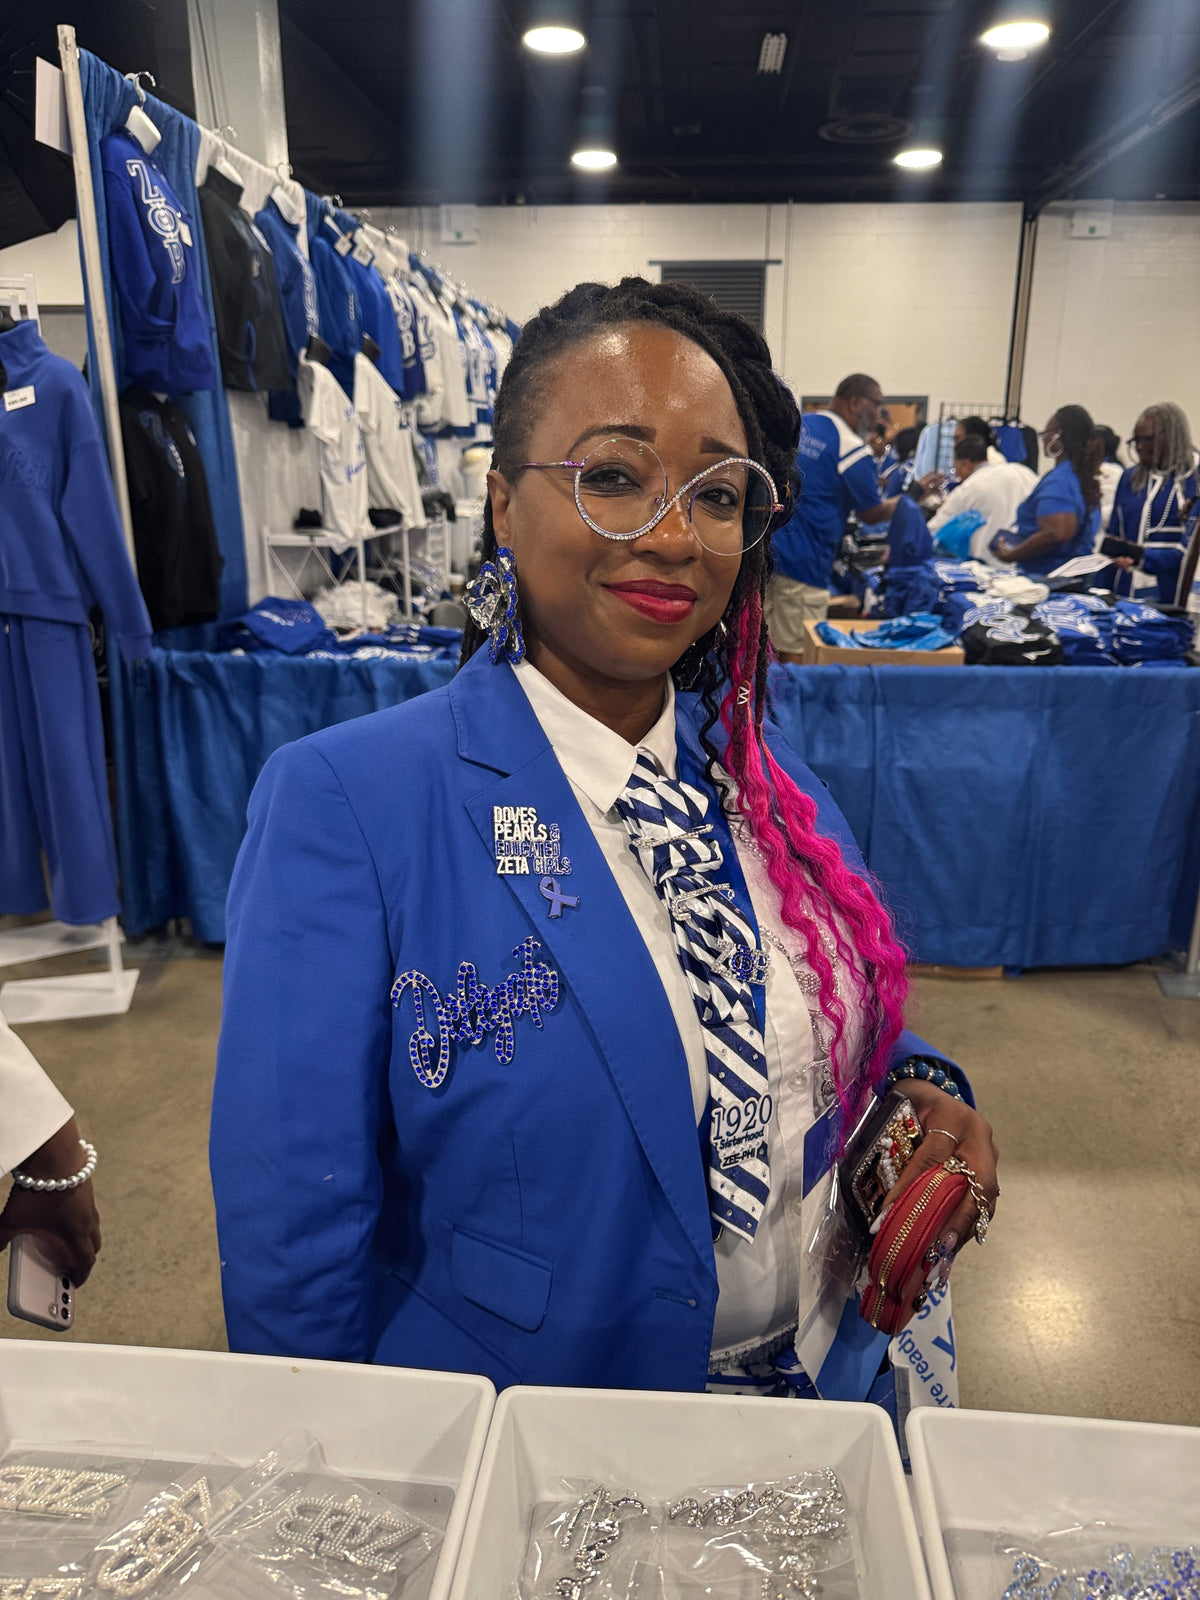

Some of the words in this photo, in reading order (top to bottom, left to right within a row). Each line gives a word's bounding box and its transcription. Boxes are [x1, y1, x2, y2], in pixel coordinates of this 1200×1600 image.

[493, 805, 538, 824] DOVES
[494, 823, 548, 841] PEARLS
[495, 840, 561, 857] EDUCATED
[496, 856, 530, 875] ZETA
[533, 857, 572, 875] GIRLS
[711, 1093, 773, 1141] 1920
[718, 1125, 765, 1150] Sisterhood
[897, 1329, 935, 1382] ready
